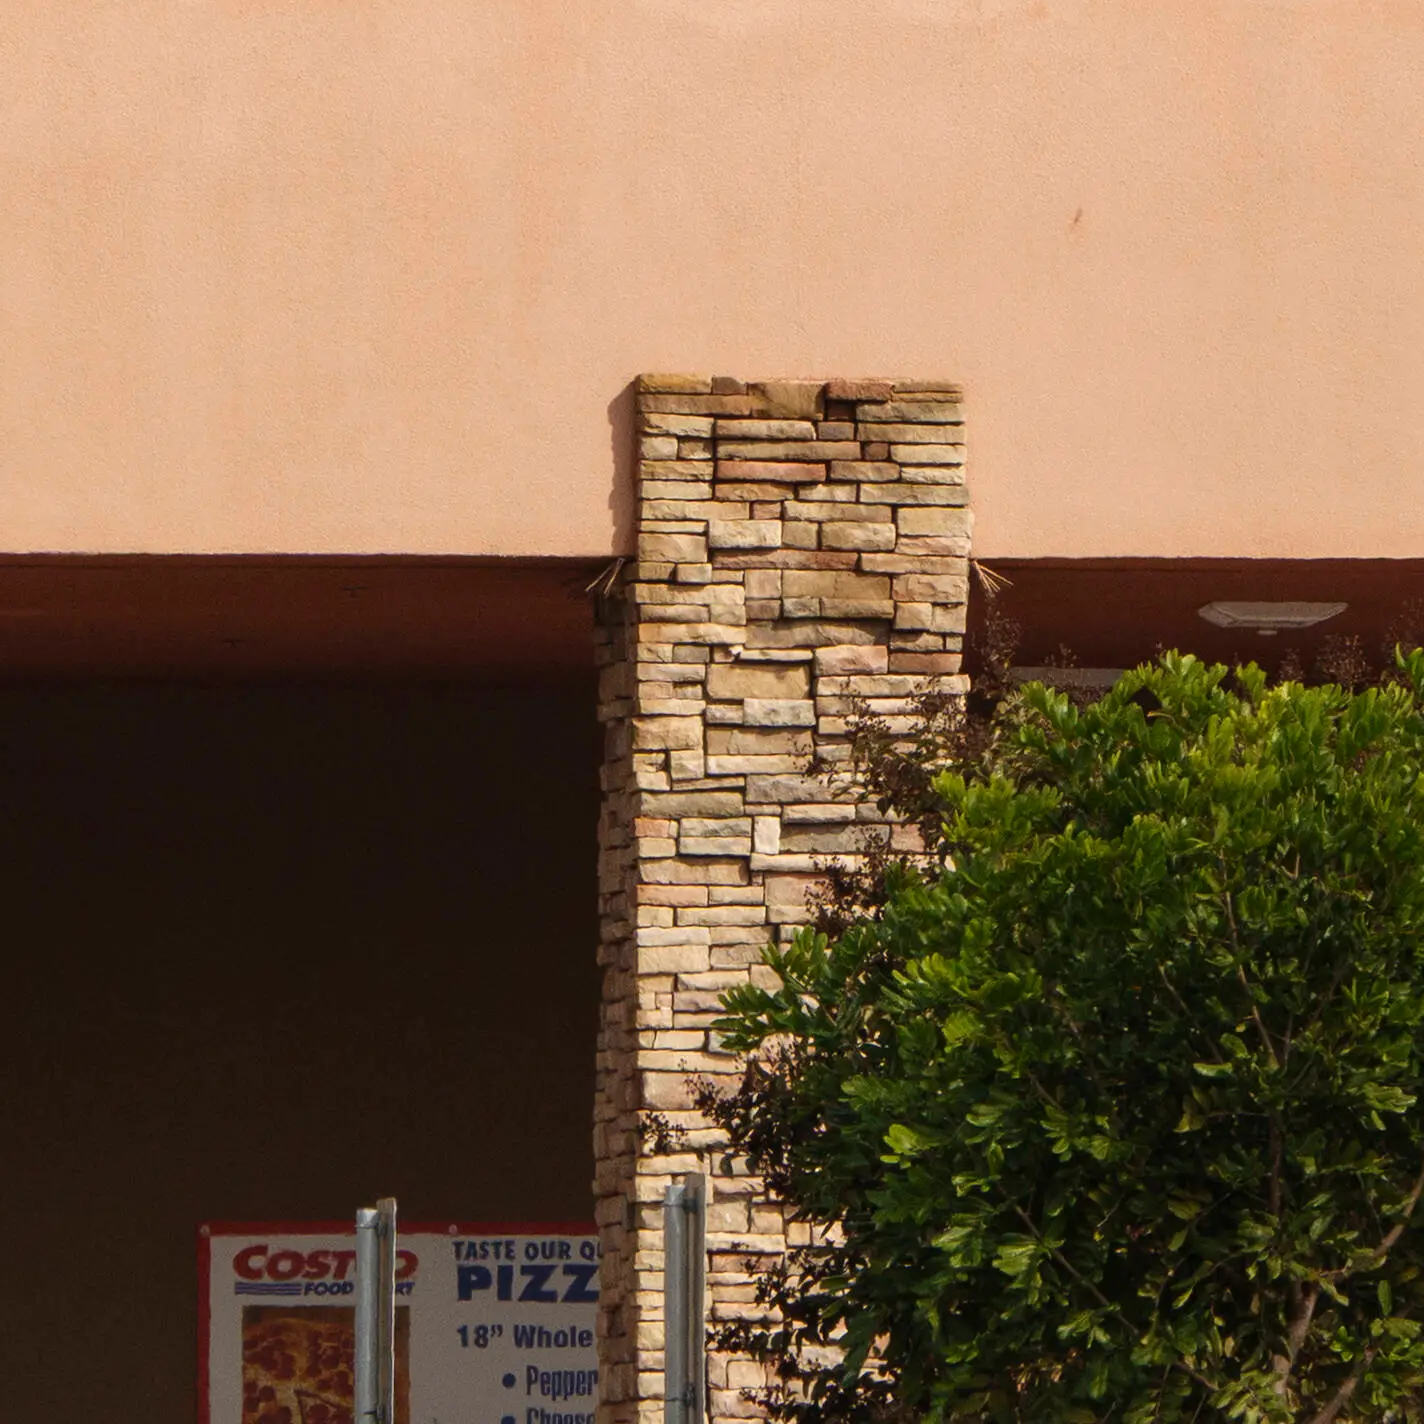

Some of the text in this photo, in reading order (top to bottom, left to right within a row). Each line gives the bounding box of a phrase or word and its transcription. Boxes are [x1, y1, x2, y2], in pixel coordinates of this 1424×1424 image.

[451, 1240, 516, 1261] TASTE
[524, 1241, 571, 1261] OUR
[232, 1244, 419, 1282] COSTO
[303, 1282, 355, 1297] FOOD
[513, 1325, 594, 1349] Whole
